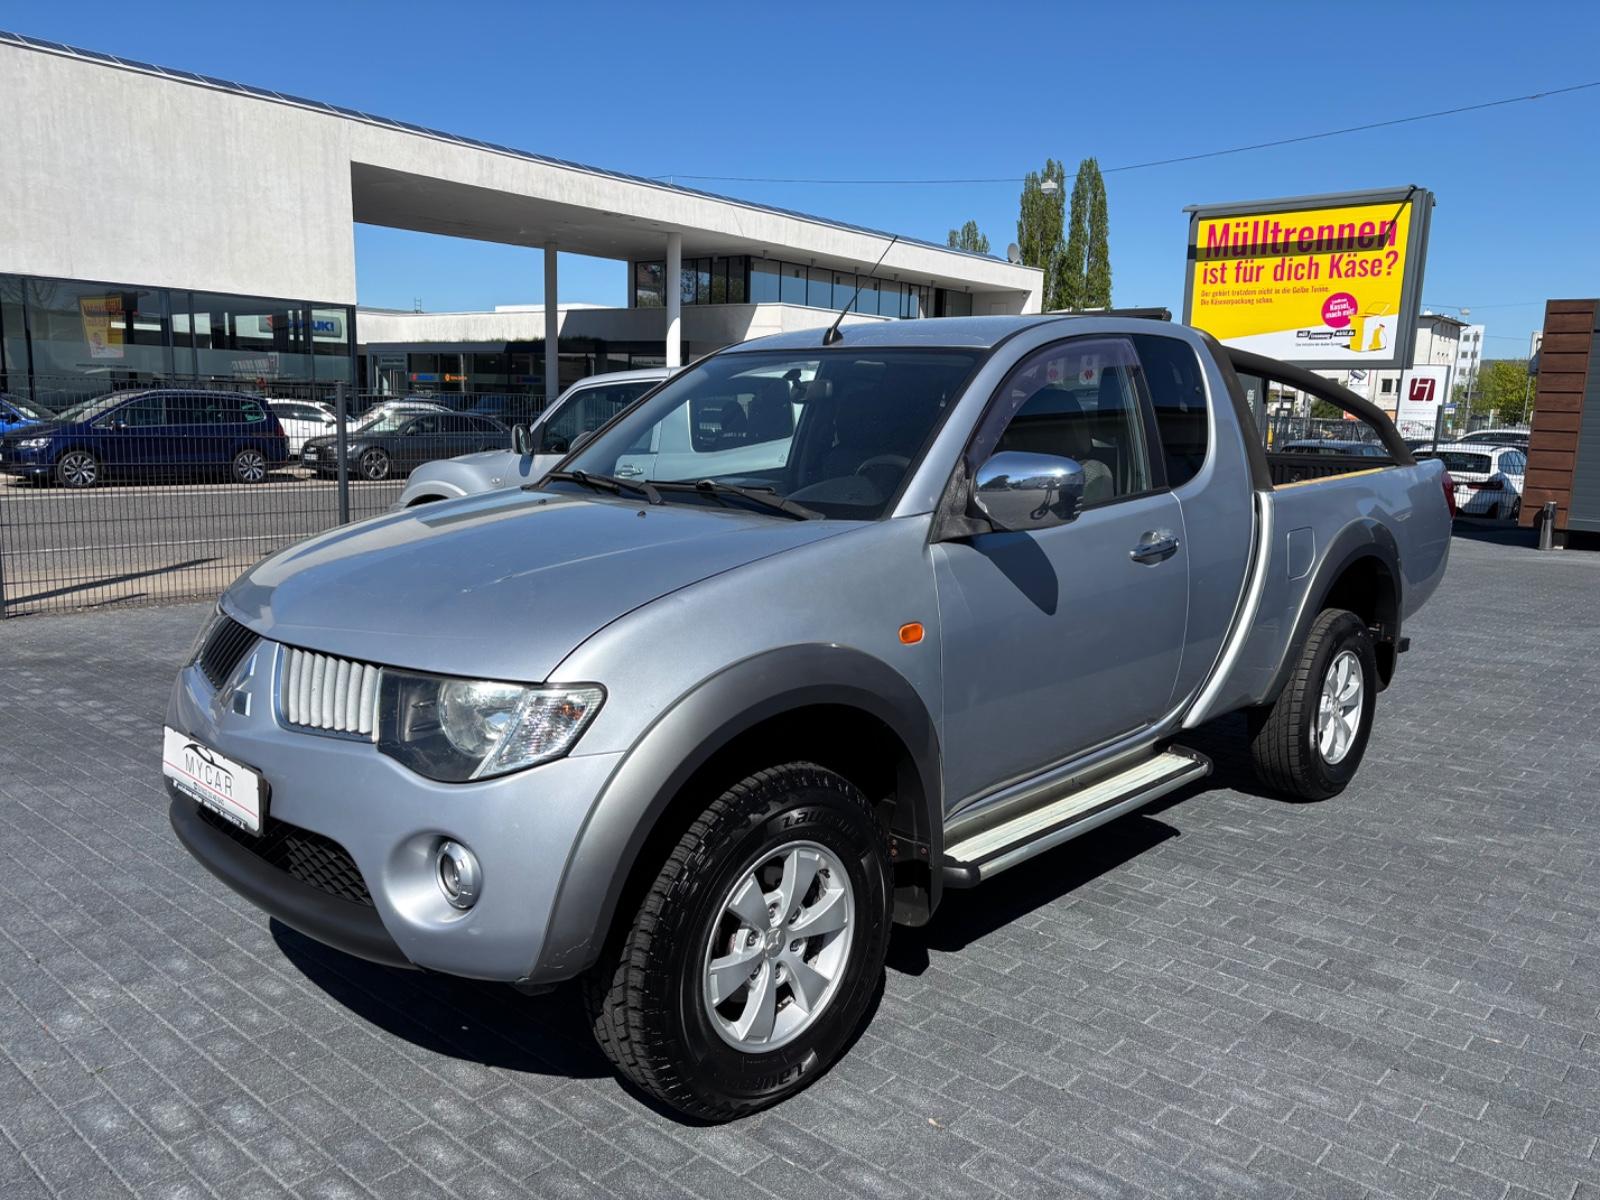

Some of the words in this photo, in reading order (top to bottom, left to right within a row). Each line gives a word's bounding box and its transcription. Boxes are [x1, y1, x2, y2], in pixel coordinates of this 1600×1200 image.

[1205, 220, 1398, 258] Mülltrennen
[1203, 262, 1227, 285] ist
[1235, 259, 1264, 283] für
[1273, 255, 1320, 281] dich
[1328, 250, 1399, 279] Käse?
[185, 753, 233, 797] MYCAR
